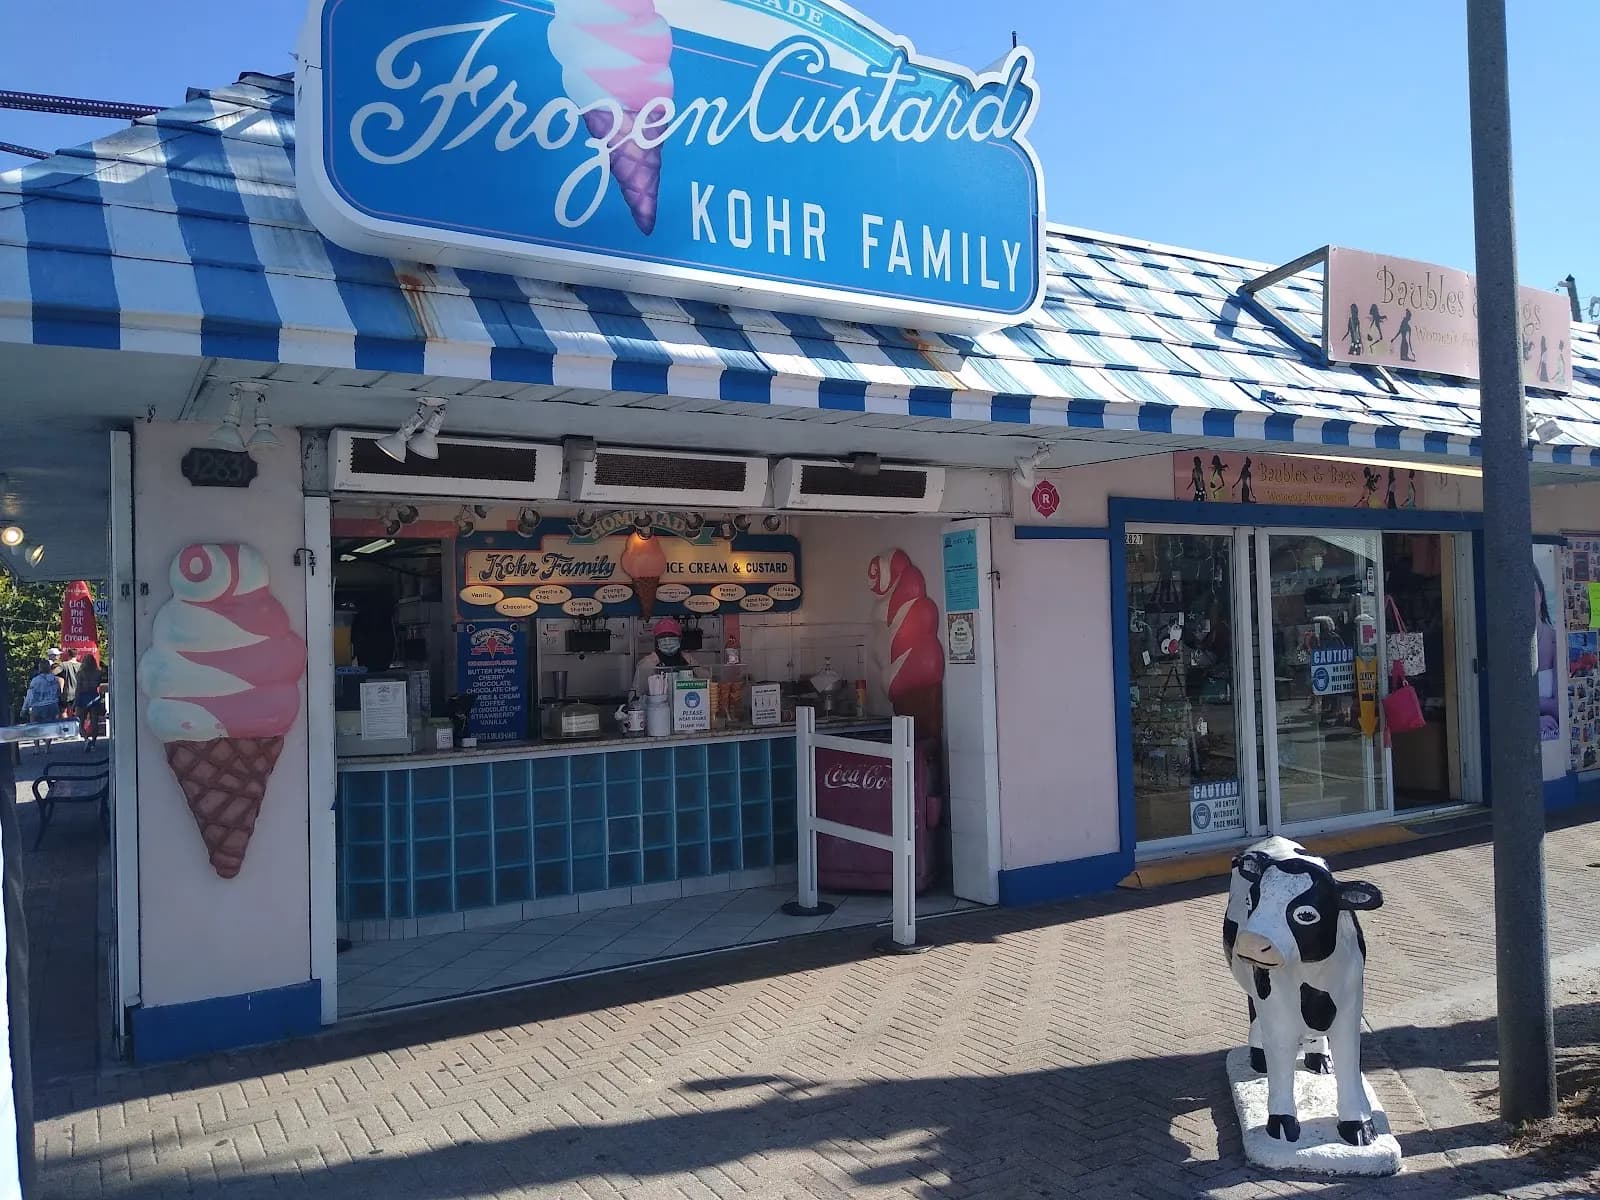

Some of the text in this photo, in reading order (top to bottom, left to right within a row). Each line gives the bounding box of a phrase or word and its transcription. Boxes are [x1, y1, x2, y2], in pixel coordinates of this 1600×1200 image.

[350, 14, 1028, 229] Frozen Custard
[690, 183, 1023, 293] KOHR FAMILY
[1377, 265, 1464, 318] Baubles
[1258, 461, 1357, 488] Baubles & Bags
[1042, 494, 1050, 504] R
[479, 552, 616, 582] Kohr Family
[666, 562, 788, 574] ICE CREAM & CUSTARD
[1313, 649, 1354, 664] CAUTION
[471, 711, 515, 720] STRAWBERRY
[824, 763, 860, 789] Coca
[1193, 781, 1238, 800] CAUTION
[1215, 800, 1222, 809] NO
[1213, 820, 1226, 829] FACE
